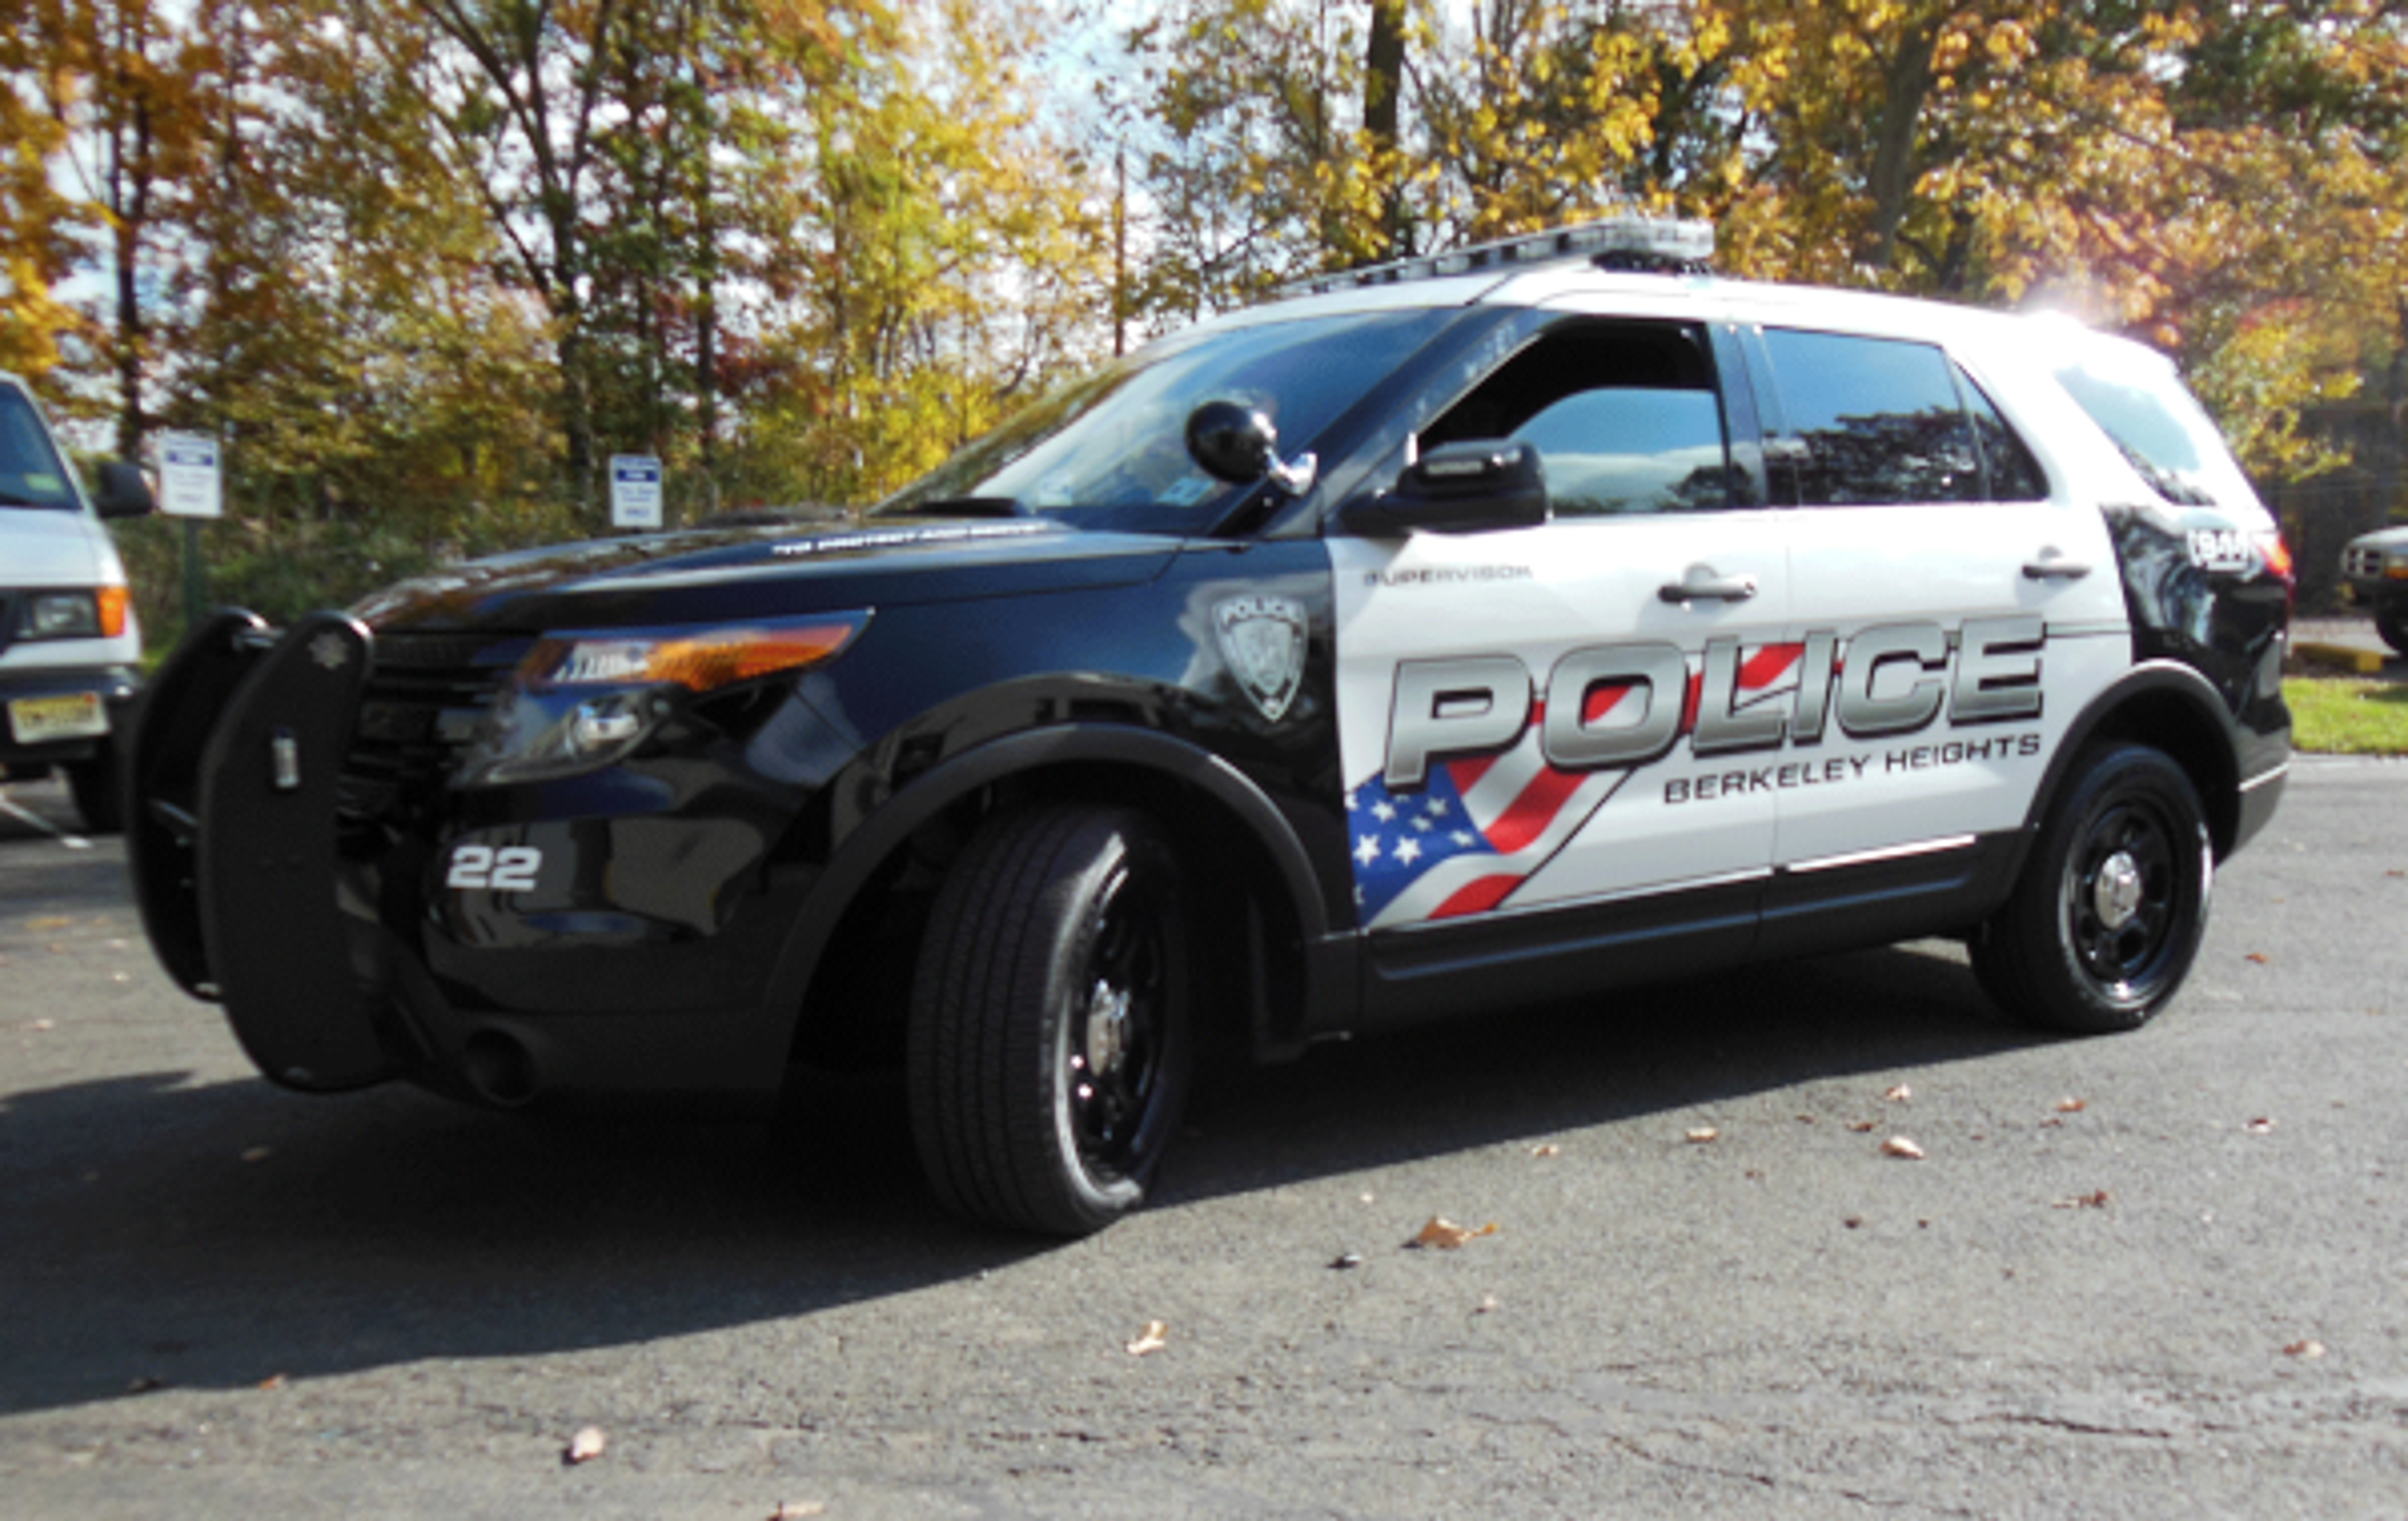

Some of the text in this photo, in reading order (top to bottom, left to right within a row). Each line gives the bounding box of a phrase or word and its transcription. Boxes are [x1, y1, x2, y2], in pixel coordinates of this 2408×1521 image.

[1363, 564, 1533, 587] SUPERVISOR
[1383, 613, 2047, 794] POLICE
[1663, 734, 2041, 804] BERKELEY HEIGHTS
[446, 846, 542, 891] 22
